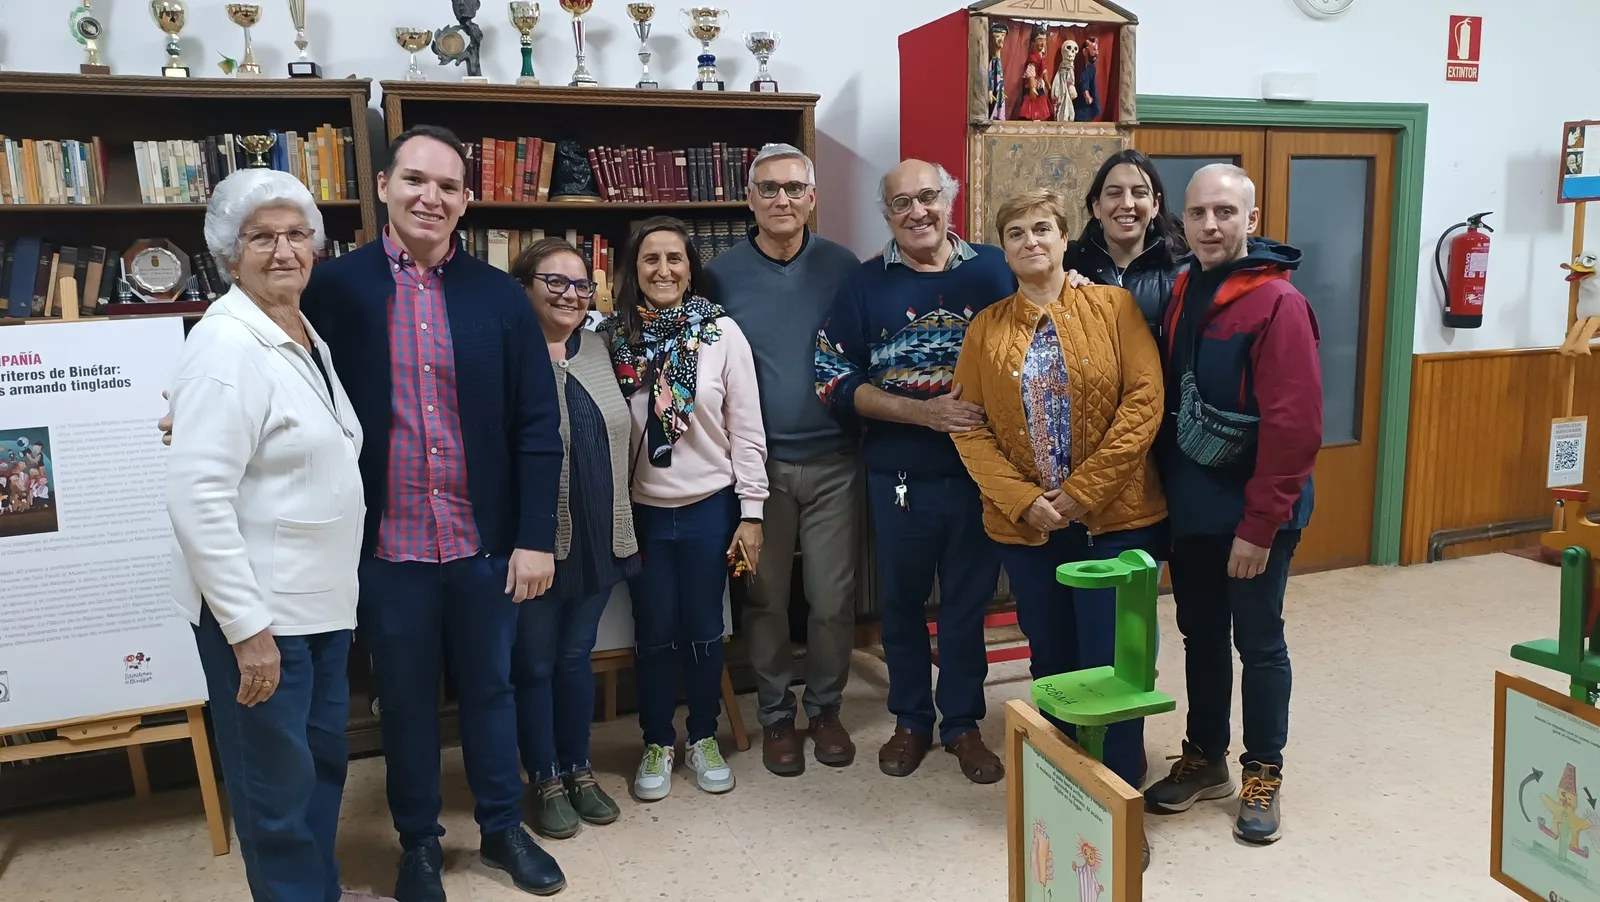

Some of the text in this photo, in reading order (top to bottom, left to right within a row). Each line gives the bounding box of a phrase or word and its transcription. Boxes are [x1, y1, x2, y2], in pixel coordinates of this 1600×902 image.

[1448, 66, 1477, 79] EXTINTOR
[0, 351, 42, 367] PAÑÍA
[0, 364, 121, 382] riteros de Binéfar:
[9, 380, 67, 396] armando
[71, 377, 132, 393] tinglados
